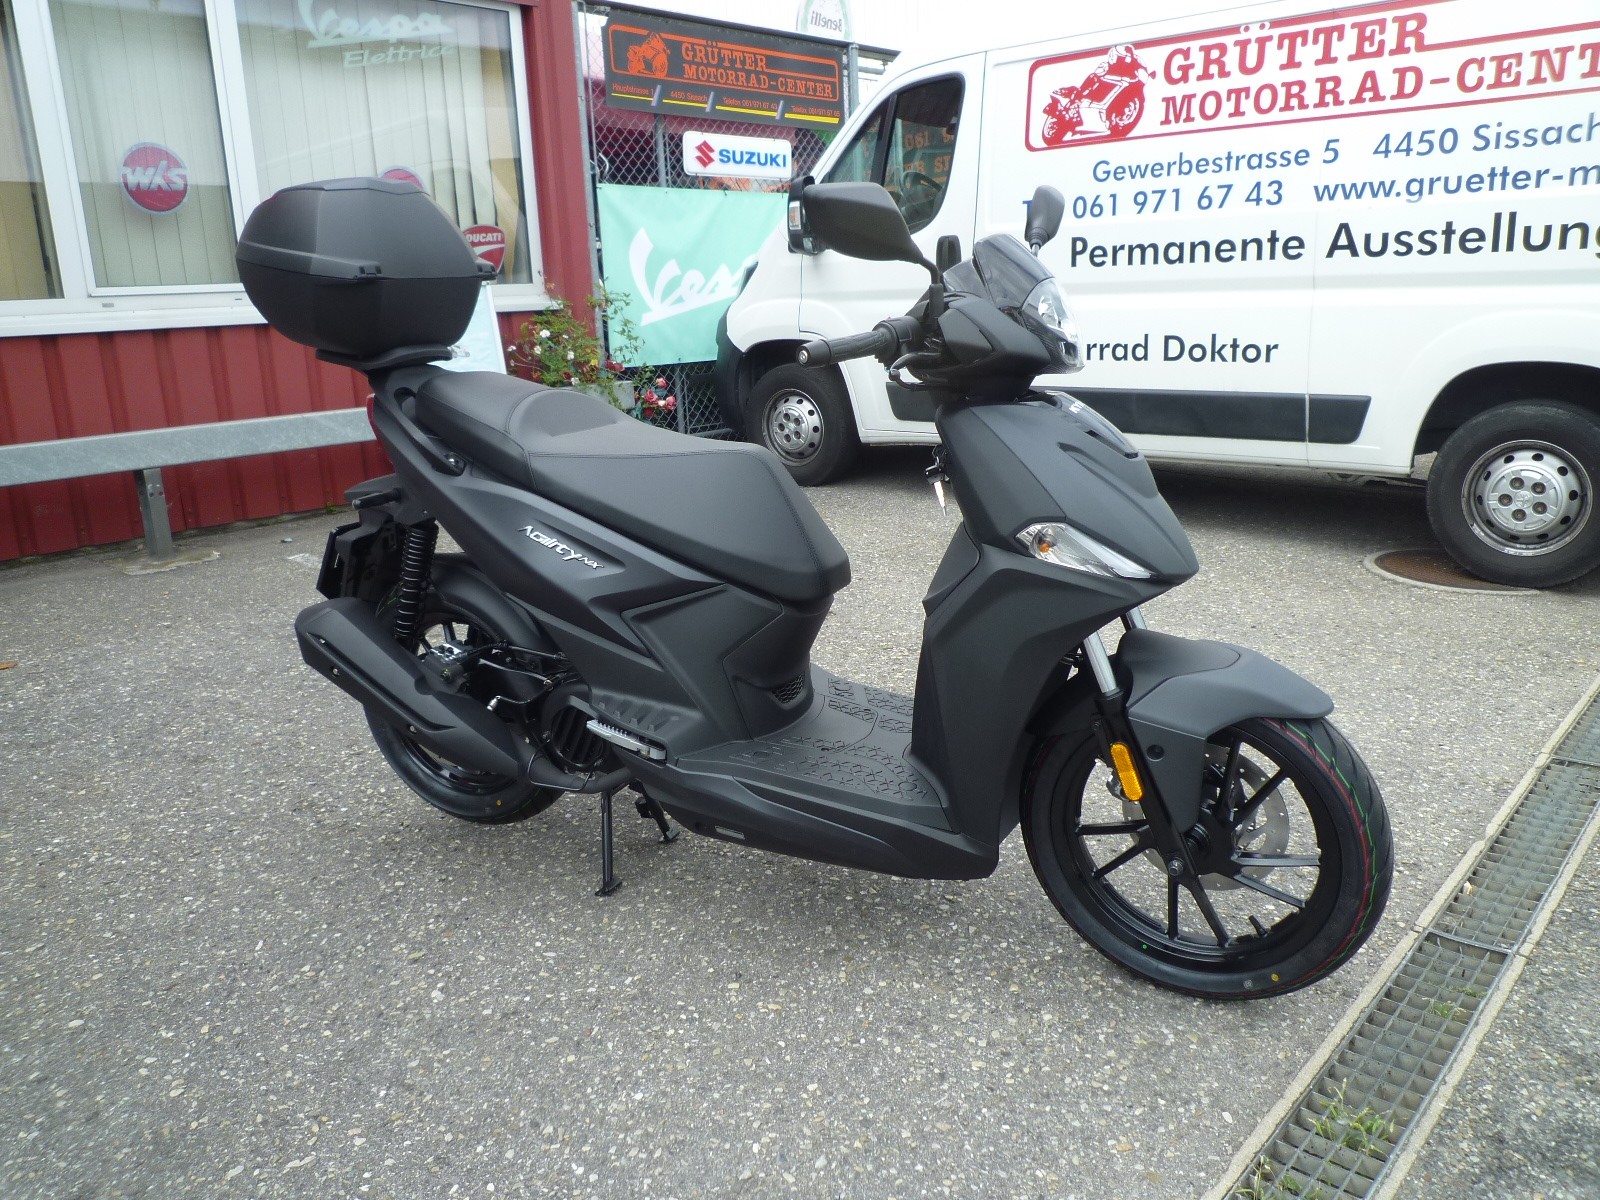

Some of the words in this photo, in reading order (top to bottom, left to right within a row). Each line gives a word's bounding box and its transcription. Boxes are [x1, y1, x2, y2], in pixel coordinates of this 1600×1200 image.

[681, 40, 768, 72] GRÜTTER
[1162, 12, 1429, 86] GRÜTTER
[682, 63, 833, 98] MOTORRAD-CENTER
[718, 148, 787, 168] SUZUKI
[1092, 149, 1311, 183] Gewerbestrasse
[1322, 138, 1340, 164] 5
[1372, 127, 1459, 160] 4450
[1072, 193, 1118, 220] 061
[1132, 186, 1182, 215] 971
[1196, 182, 1233, 210] 67
[1244, 179, 1284, 207] 43
[465, 232, 503, 243] DUCATI
[1070, 229, 1306, 268] Permanente
[1324, 211, 1600, 260] Ausstellun
[1162, 333, 1280, 364] Doktor
